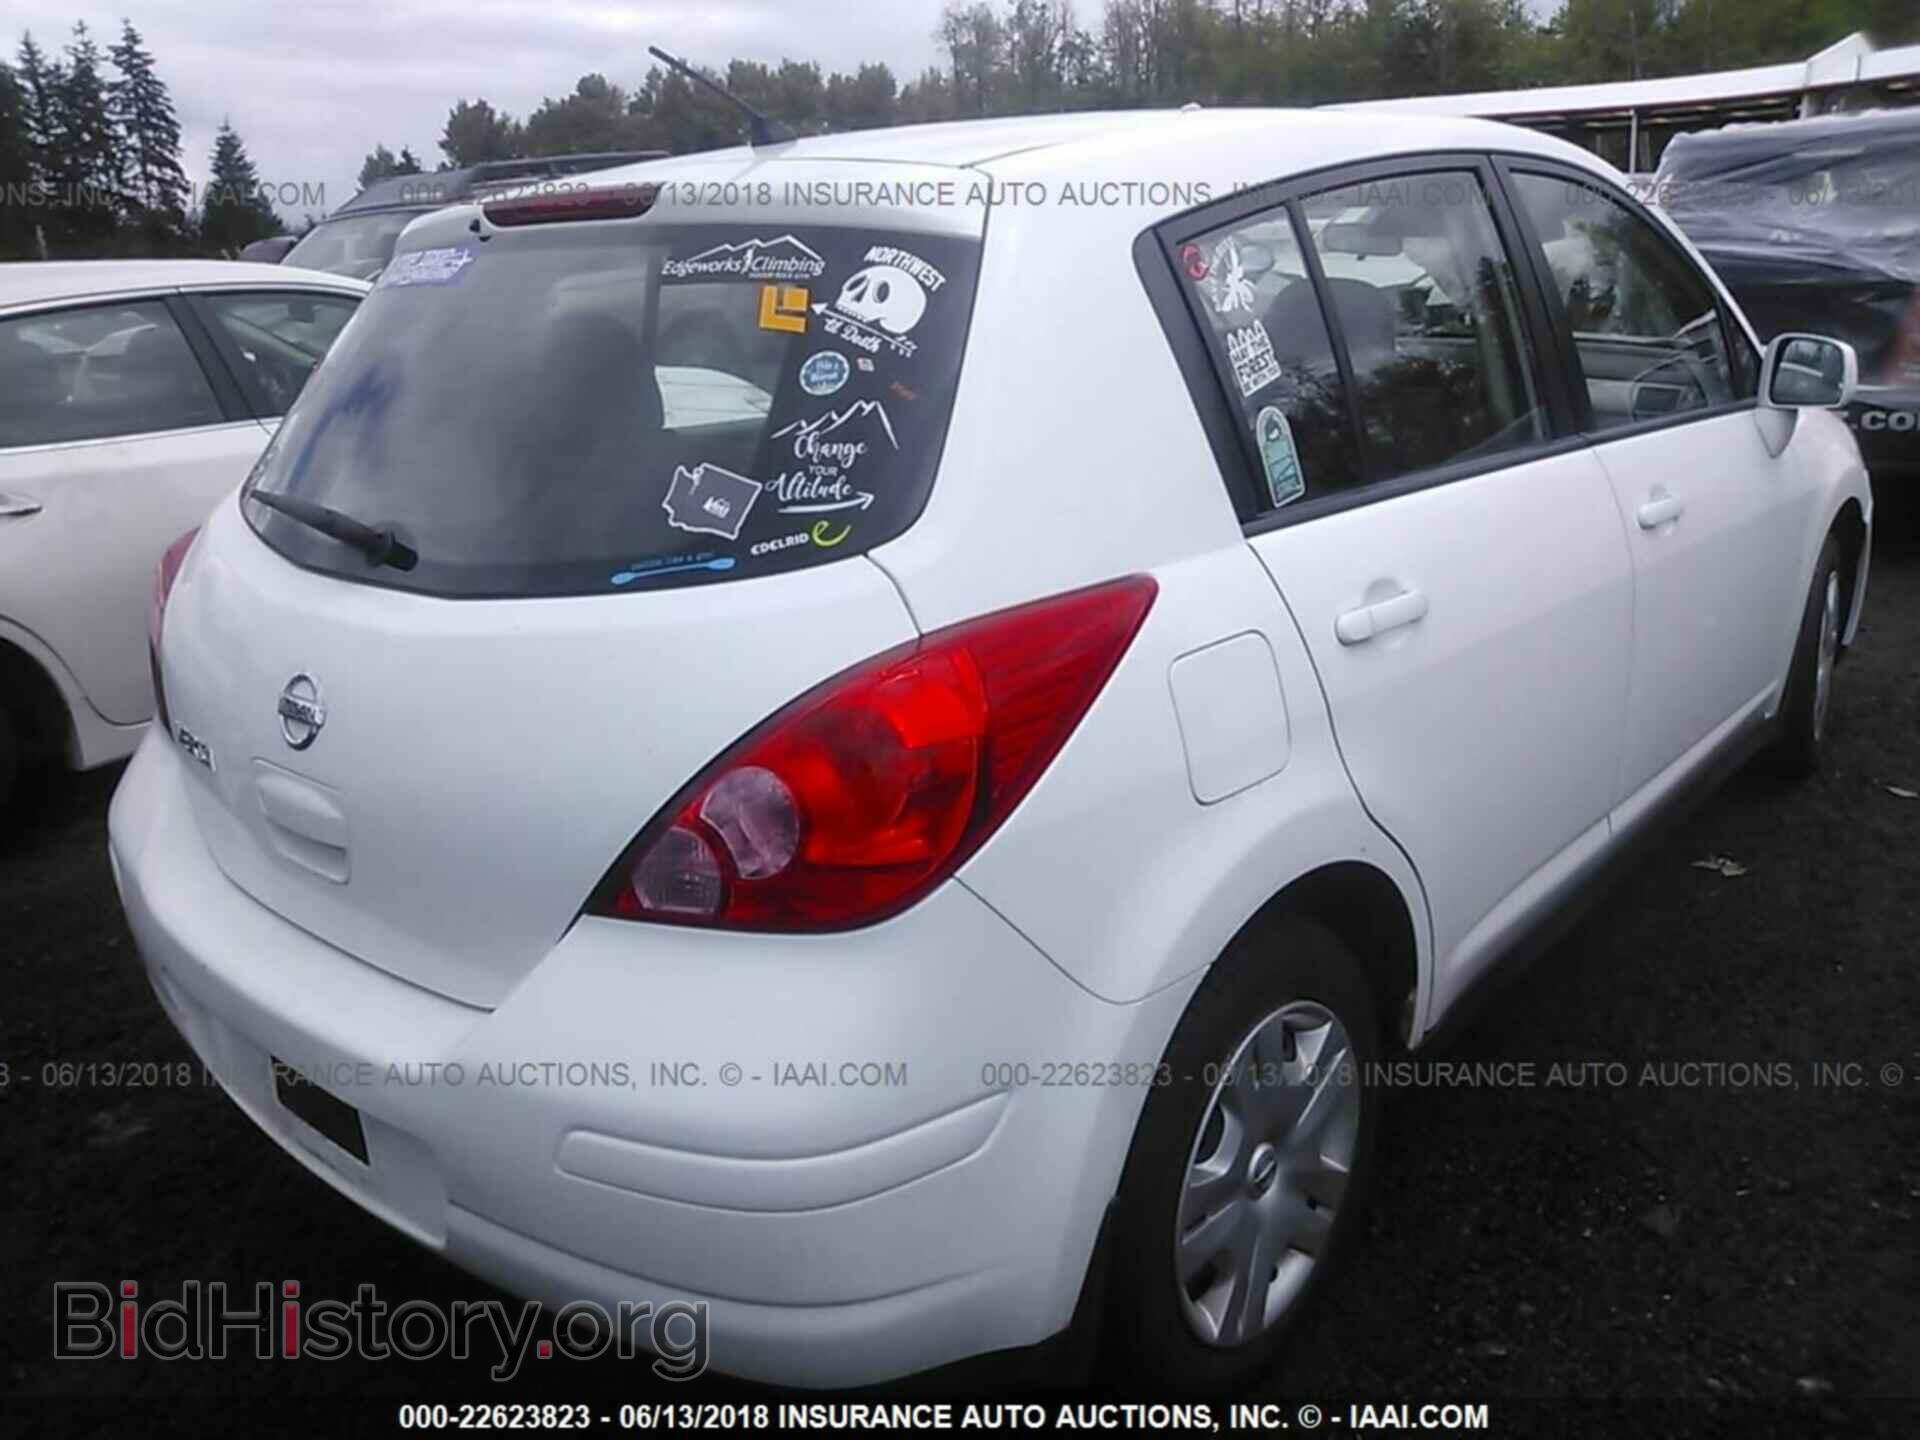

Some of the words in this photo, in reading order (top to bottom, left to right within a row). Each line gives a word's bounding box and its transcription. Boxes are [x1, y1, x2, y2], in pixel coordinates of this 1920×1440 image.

[661, 257, 742, 278] Edgeworks
[751, 255, 826, 276] Climbing
[863, 246, 946, 291] NORTHWEST
[1236, 348, 1276, 379] FOREST
[793, 430, 867, 469] Change
[764, 470, 853, 502] Altitude
[809, 464, 838, 477] YOUR
